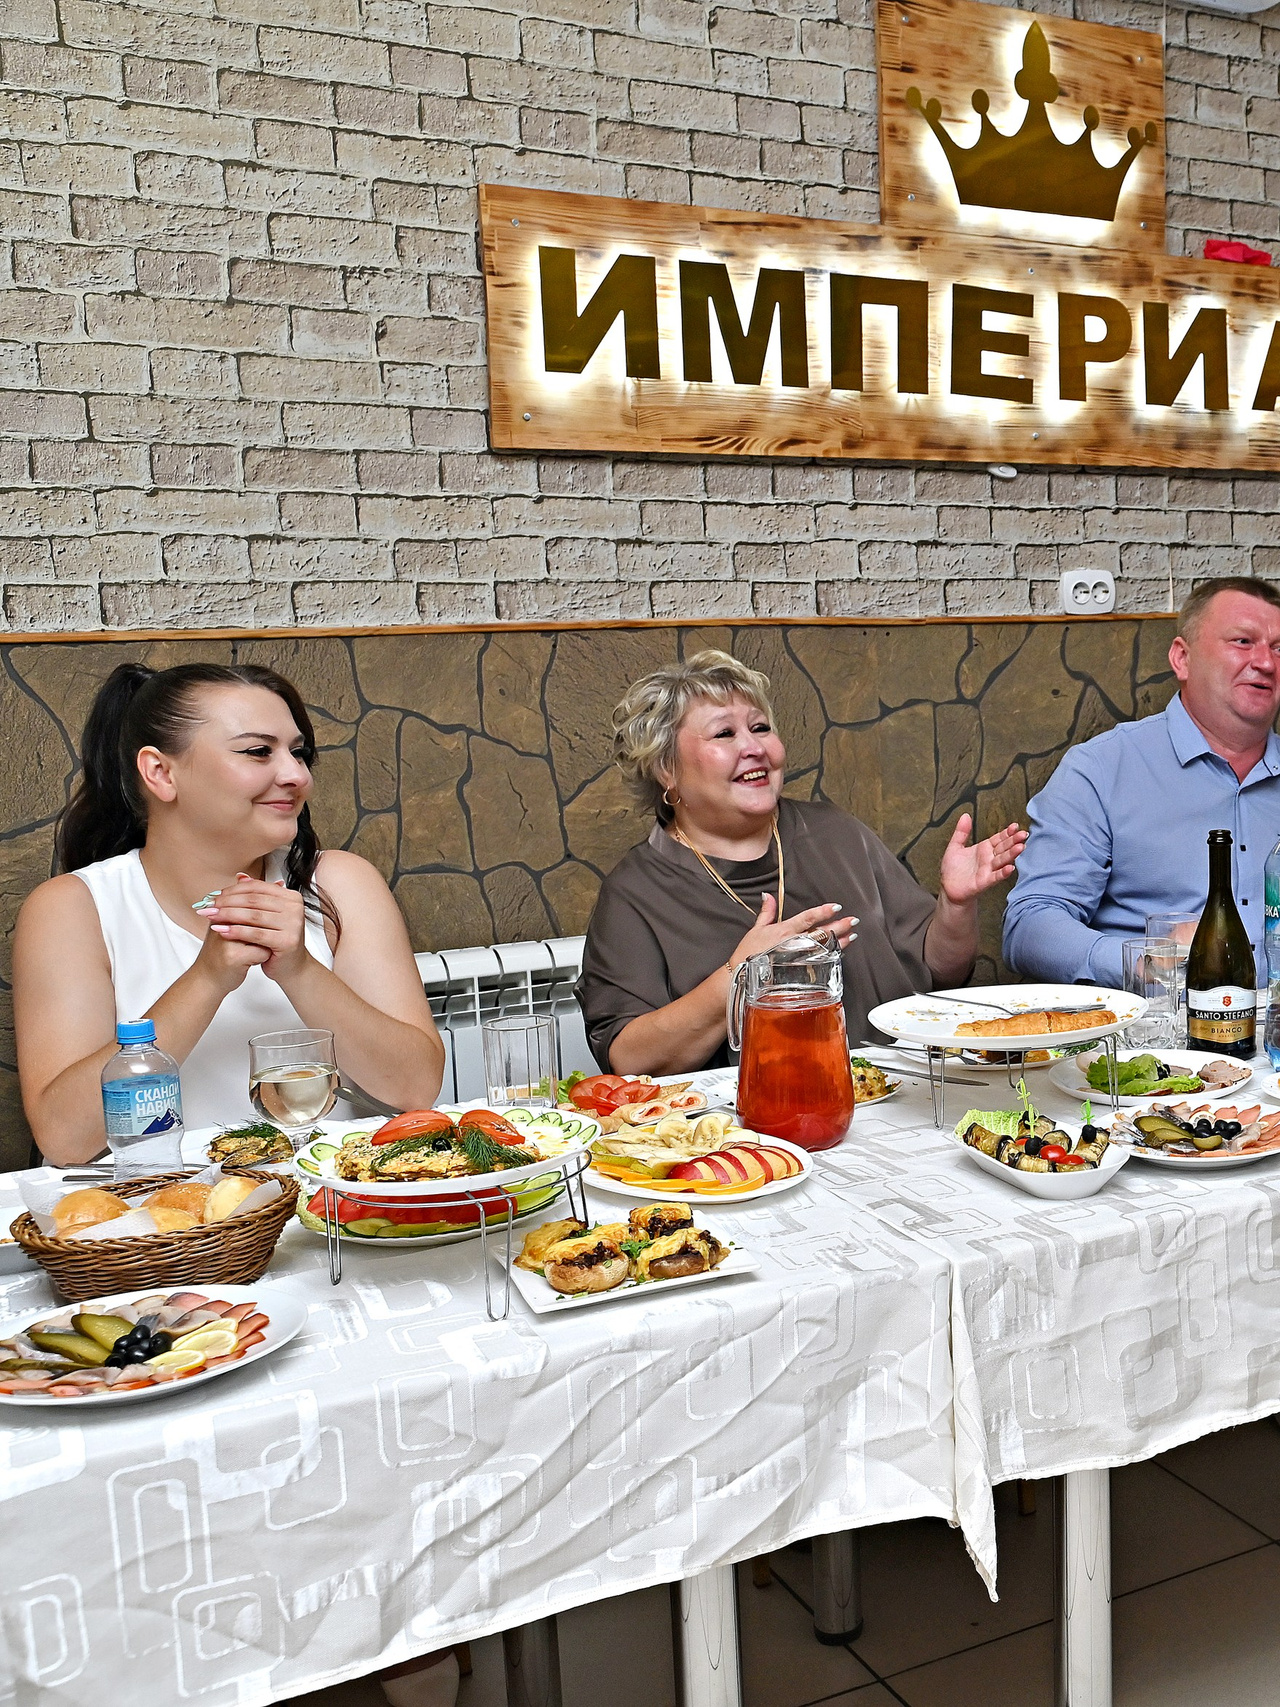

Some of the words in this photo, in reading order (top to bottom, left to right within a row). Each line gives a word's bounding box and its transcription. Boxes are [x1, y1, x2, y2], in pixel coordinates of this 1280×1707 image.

[1195, 1010, 1221, 1020] SANTO
[1223, 1008, 1254, 1020] STEFANO
[1211, 1026, 1242, 1034] BIANCO
[135, 1081, 180, 1103] СКАНДИ
[135, 1096, 177, 1117] НАВИЯ
